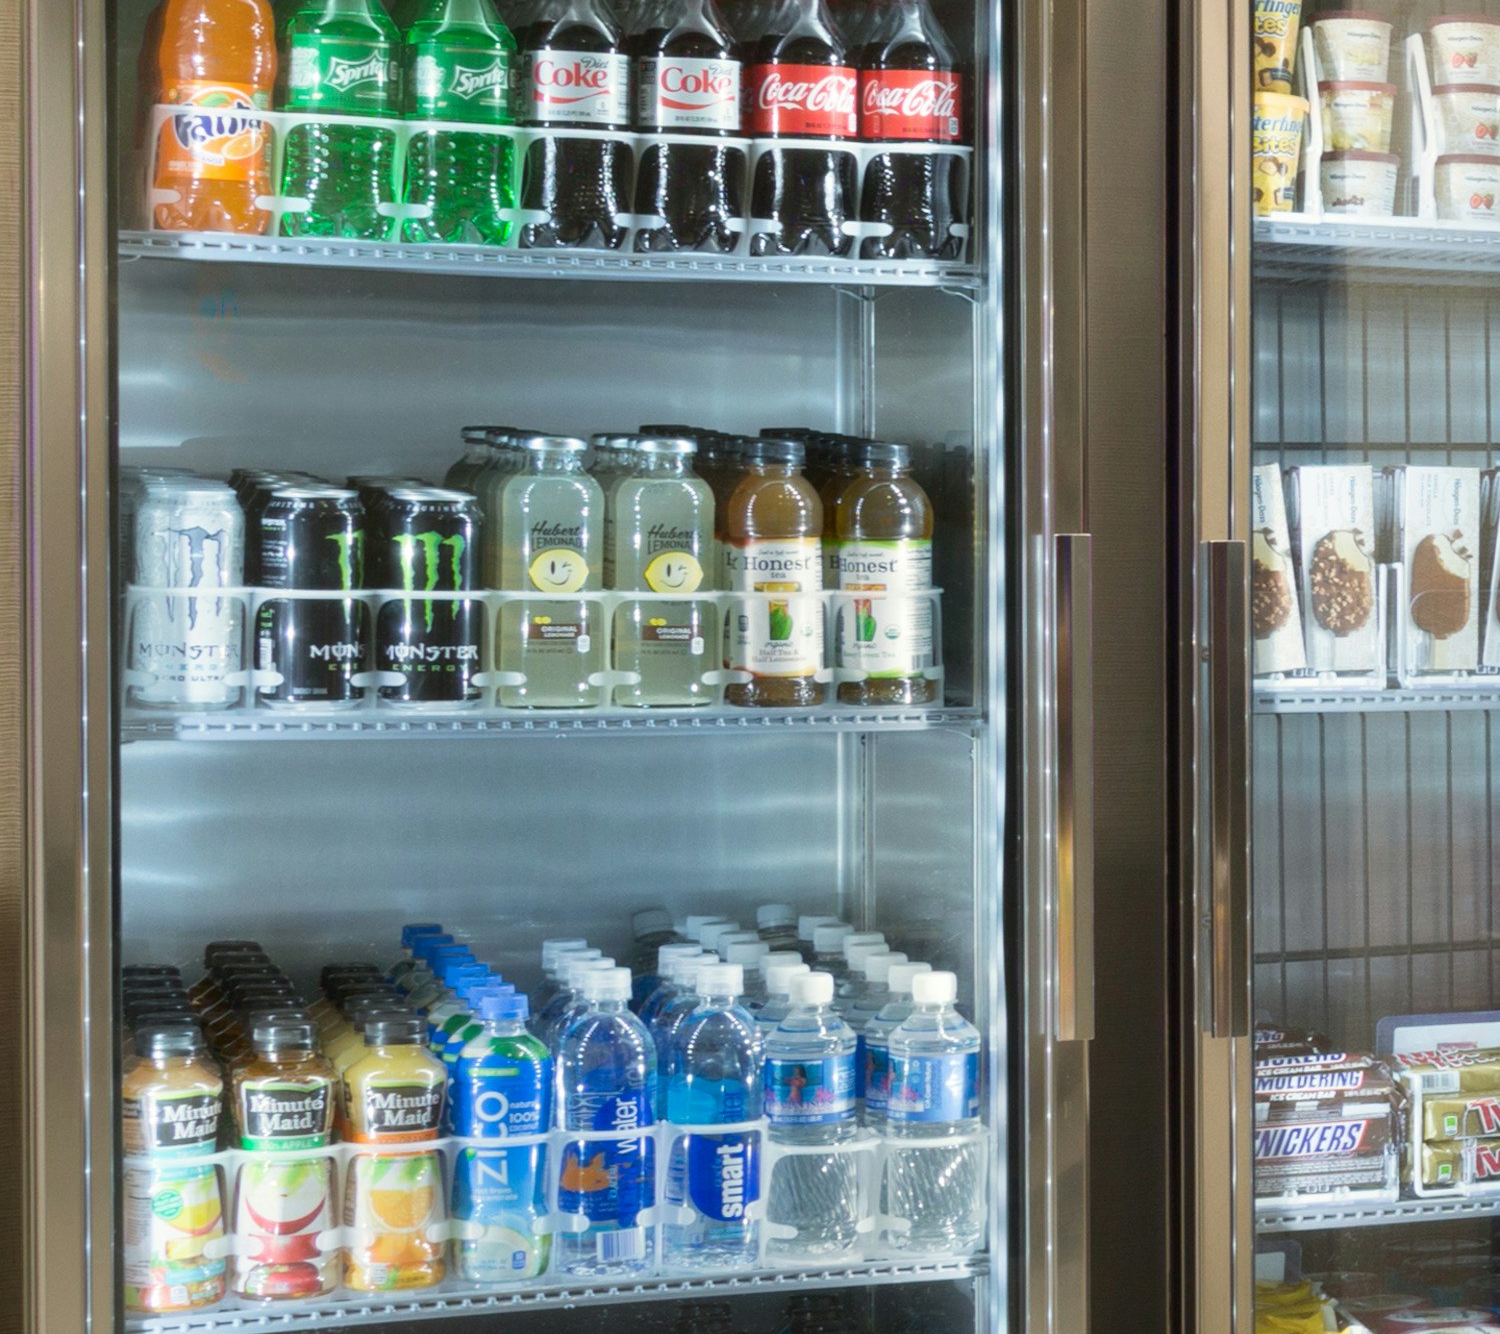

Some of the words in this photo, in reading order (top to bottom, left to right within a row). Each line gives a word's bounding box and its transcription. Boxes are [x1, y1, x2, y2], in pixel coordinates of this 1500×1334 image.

[330, 55, 387, 88] Sprite
[457, 63, 505, 95] Sprite
[534, 59, 607, 92] Coke
[660, 66, 732, 95] Coke
[758, 73, 856, 114] Coca-Cola
[863, 78, 956, 119] Coca-Cola
[744, 556, 811, 571] Honest
[840, 558, 898, 573] Honest
[386, 643, 479, 661] MONSTER
[392, 663, 468, 672] ENERGY
[250, 1094, 324, 1114] Minute
[375, 1093, 440, 1110] Minute
[1270, 1093, 1285, 1101] ICE
[1286, 1092, 1317, 1100] CREAM
[1317, 1091, 1336, 1099] BAR
[261, 1114, 312, 1131] Maid
[384, 1108, 432, 1127] Maid
[174, 1118, 218, 1140] Maid
[717, 1143, 744, 1218] smart
